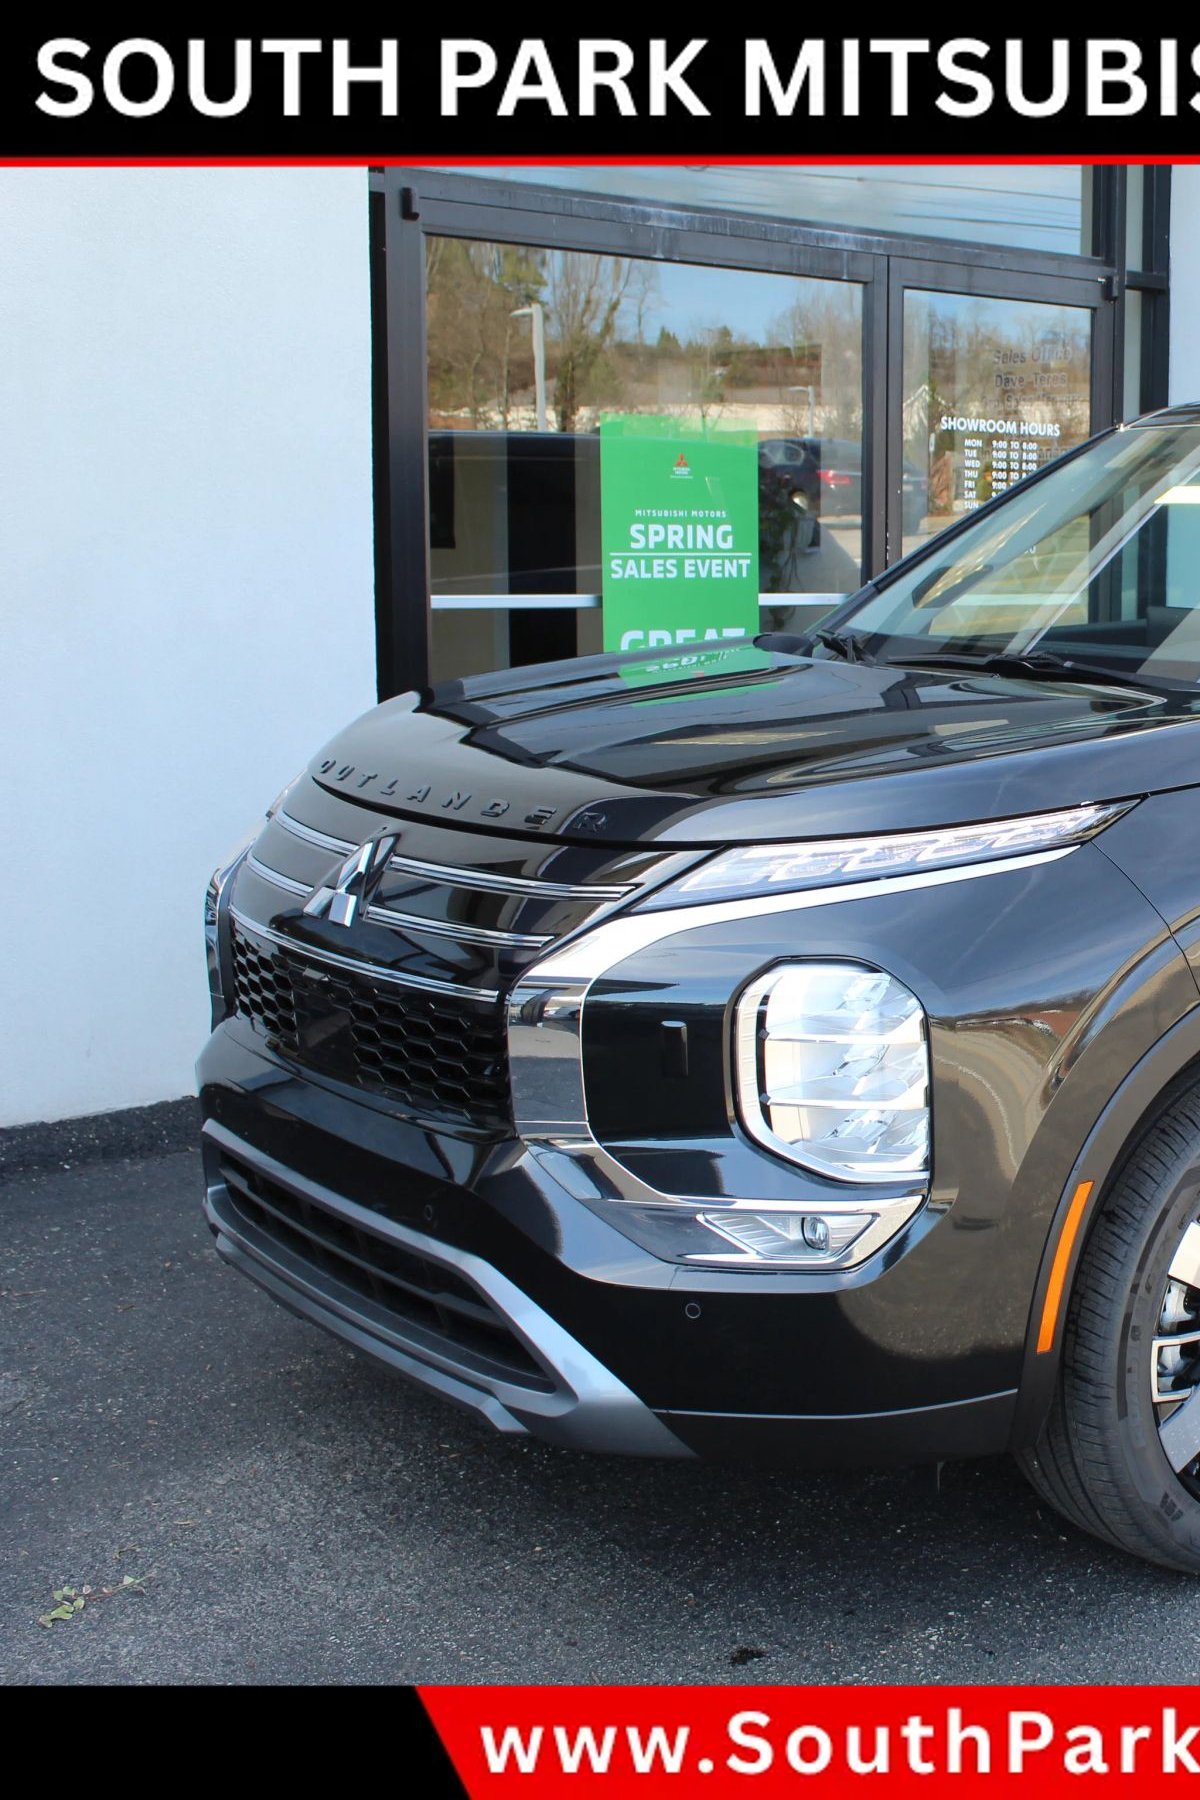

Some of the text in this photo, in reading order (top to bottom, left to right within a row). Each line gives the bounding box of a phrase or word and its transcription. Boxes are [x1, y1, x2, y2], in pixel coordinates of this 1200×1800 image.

[940, 416, 1061, 437] SHOWROOM HOURS
[964, 439, 1037, 450] MON 9:00 TO 8:00
[964, 449, 977, 458] TUE
[992, 450, 1007, 459] 9:00
[1010, 451, 1019, 460] TO
[1022, 452, 1037, 460] 8:00
[964, 460, 1037, 471] WED 9:00 TO 8:00
[964, 470, 979, 478] THU
[992, 471, 1007, 479] 9:00
[1010, 472, 1019, 480] TO
[964, 480, 975, 488] FRI
[992, 481, 1007, 489] 9:00
[964, 490, 976, 499] SAT
[964, 501, 979, 509] SUN
[635, 508, 727, 519] MITSUBISHI MOTORS
[629, 523, 733, 549] SPRING
[610, 558, 751, 579] SALES EVENT
[320, 759, 607, 833] OUTLANDER
